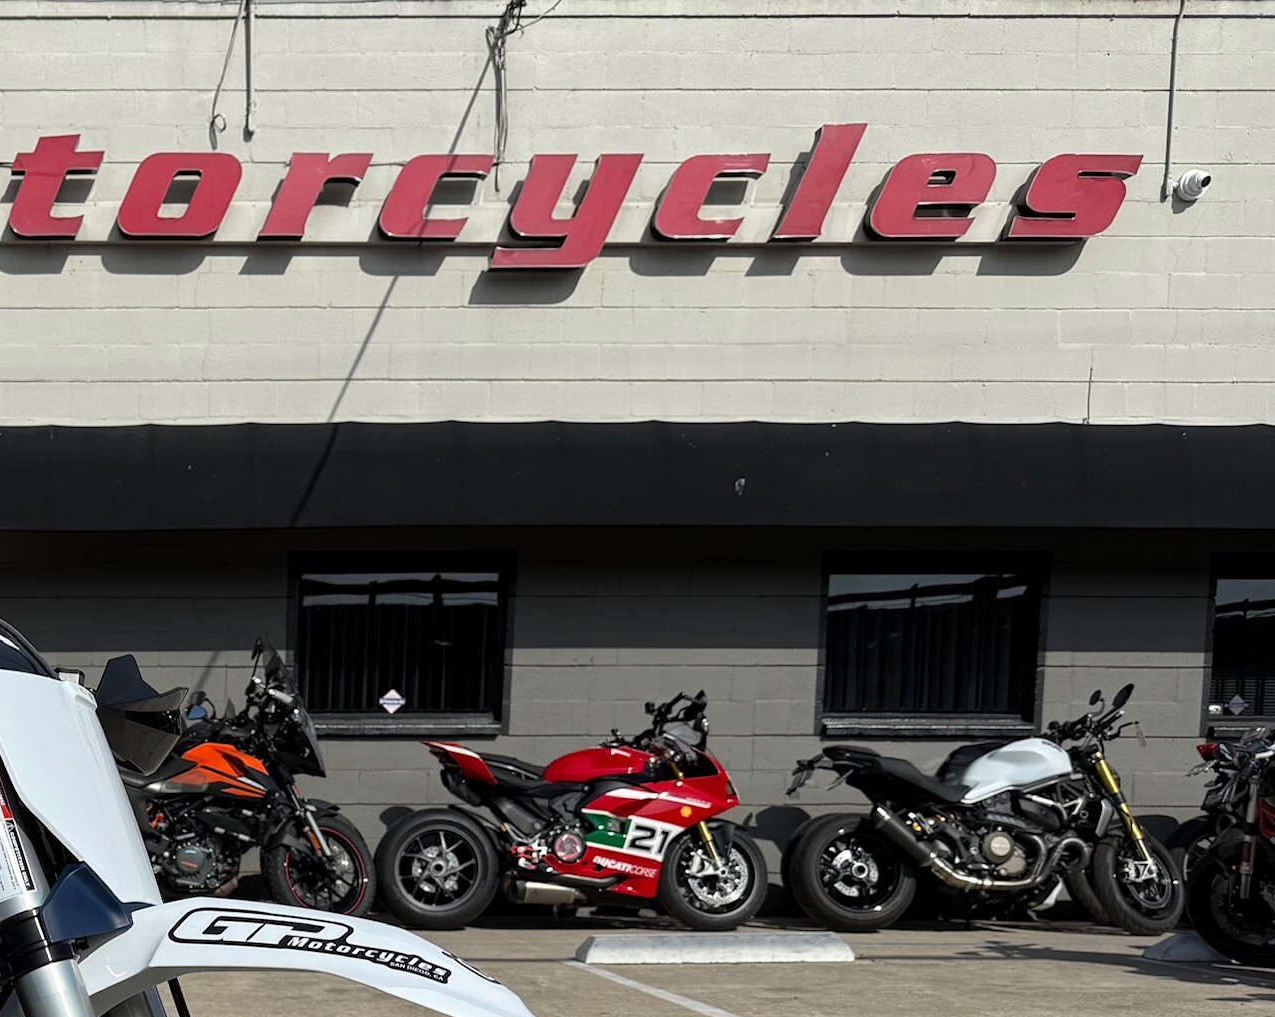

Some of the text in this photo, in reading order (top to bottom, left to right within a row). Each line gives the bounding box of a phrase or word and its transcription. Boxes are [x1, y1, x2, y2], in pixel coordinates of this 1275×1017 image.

[629, 825, 670, 854] 21
[287, 935, 448, 976] Motorcycles
[389, 961, 405, 969] SAN
[433, 974, 444, 982] CA
